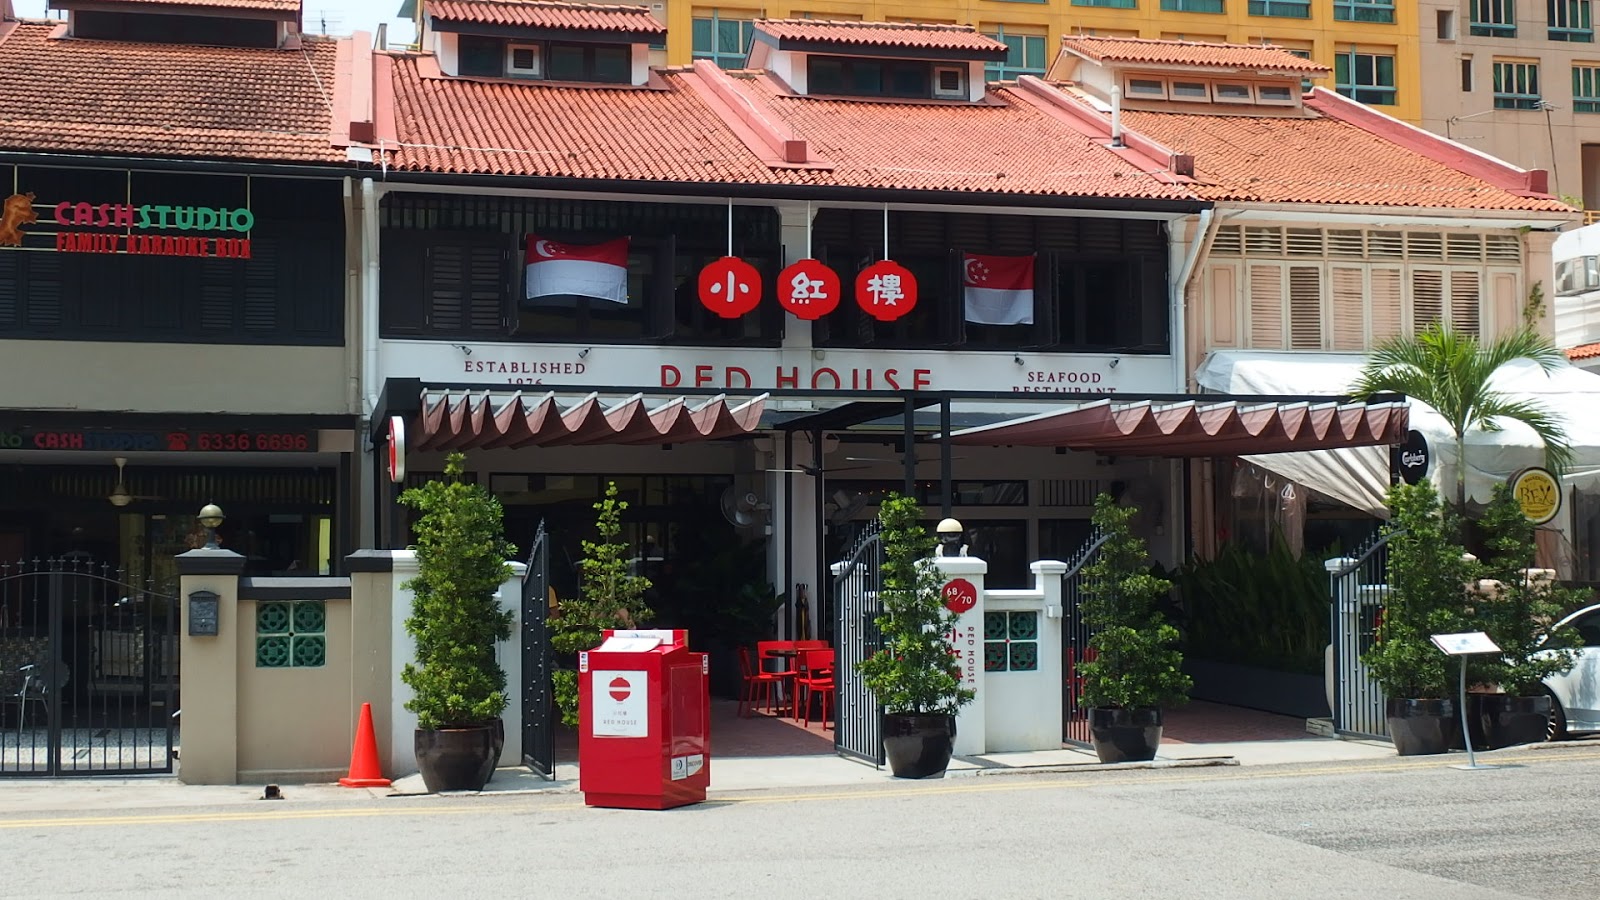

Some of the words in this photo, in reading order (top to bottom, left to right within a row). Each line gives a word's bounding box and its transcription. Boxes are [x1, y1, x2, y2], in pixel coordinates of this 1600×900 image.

[54, 201, 134, 228] CASH
[138, 204, 254, 232] STUDIO
[56, 231, 120, 254] FAMILY
[127, 234, 209, 258] KARAOKE
[215, 237, 251, 259] BOX
[464, 360, 586, 374] ESTABLISHED
[1027, 371, 1102, 383] SEAFOOD
[33, 432, 84, 449] CASH
[198, 433, 251, 449] 6336
[256, 433, 309, 449] 6696
[1401, 450, 1425, 466] Carlsberg
